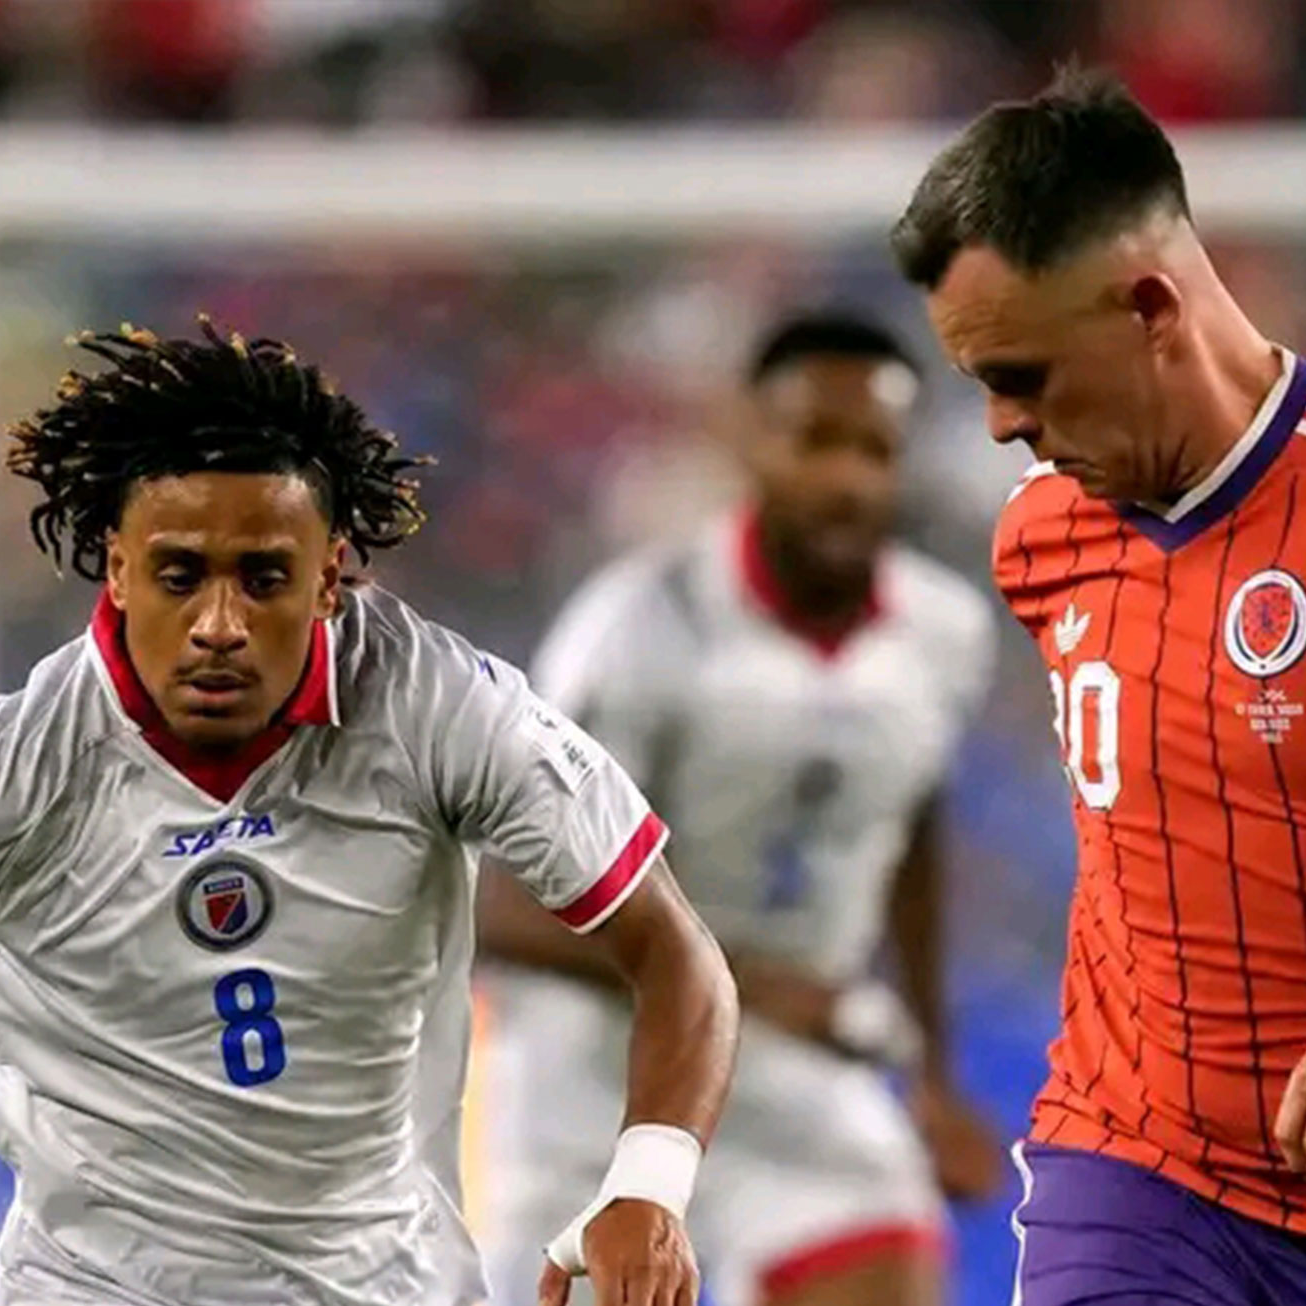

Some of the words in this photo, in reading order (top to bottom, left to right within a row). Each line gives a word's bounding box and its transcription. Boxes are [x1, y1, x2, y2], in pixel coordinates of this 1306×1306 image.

[1050, 660, 1121, 812] 0
[162, 814, 275, 857] SAETA
[213, 967, 285, 1087] 8
